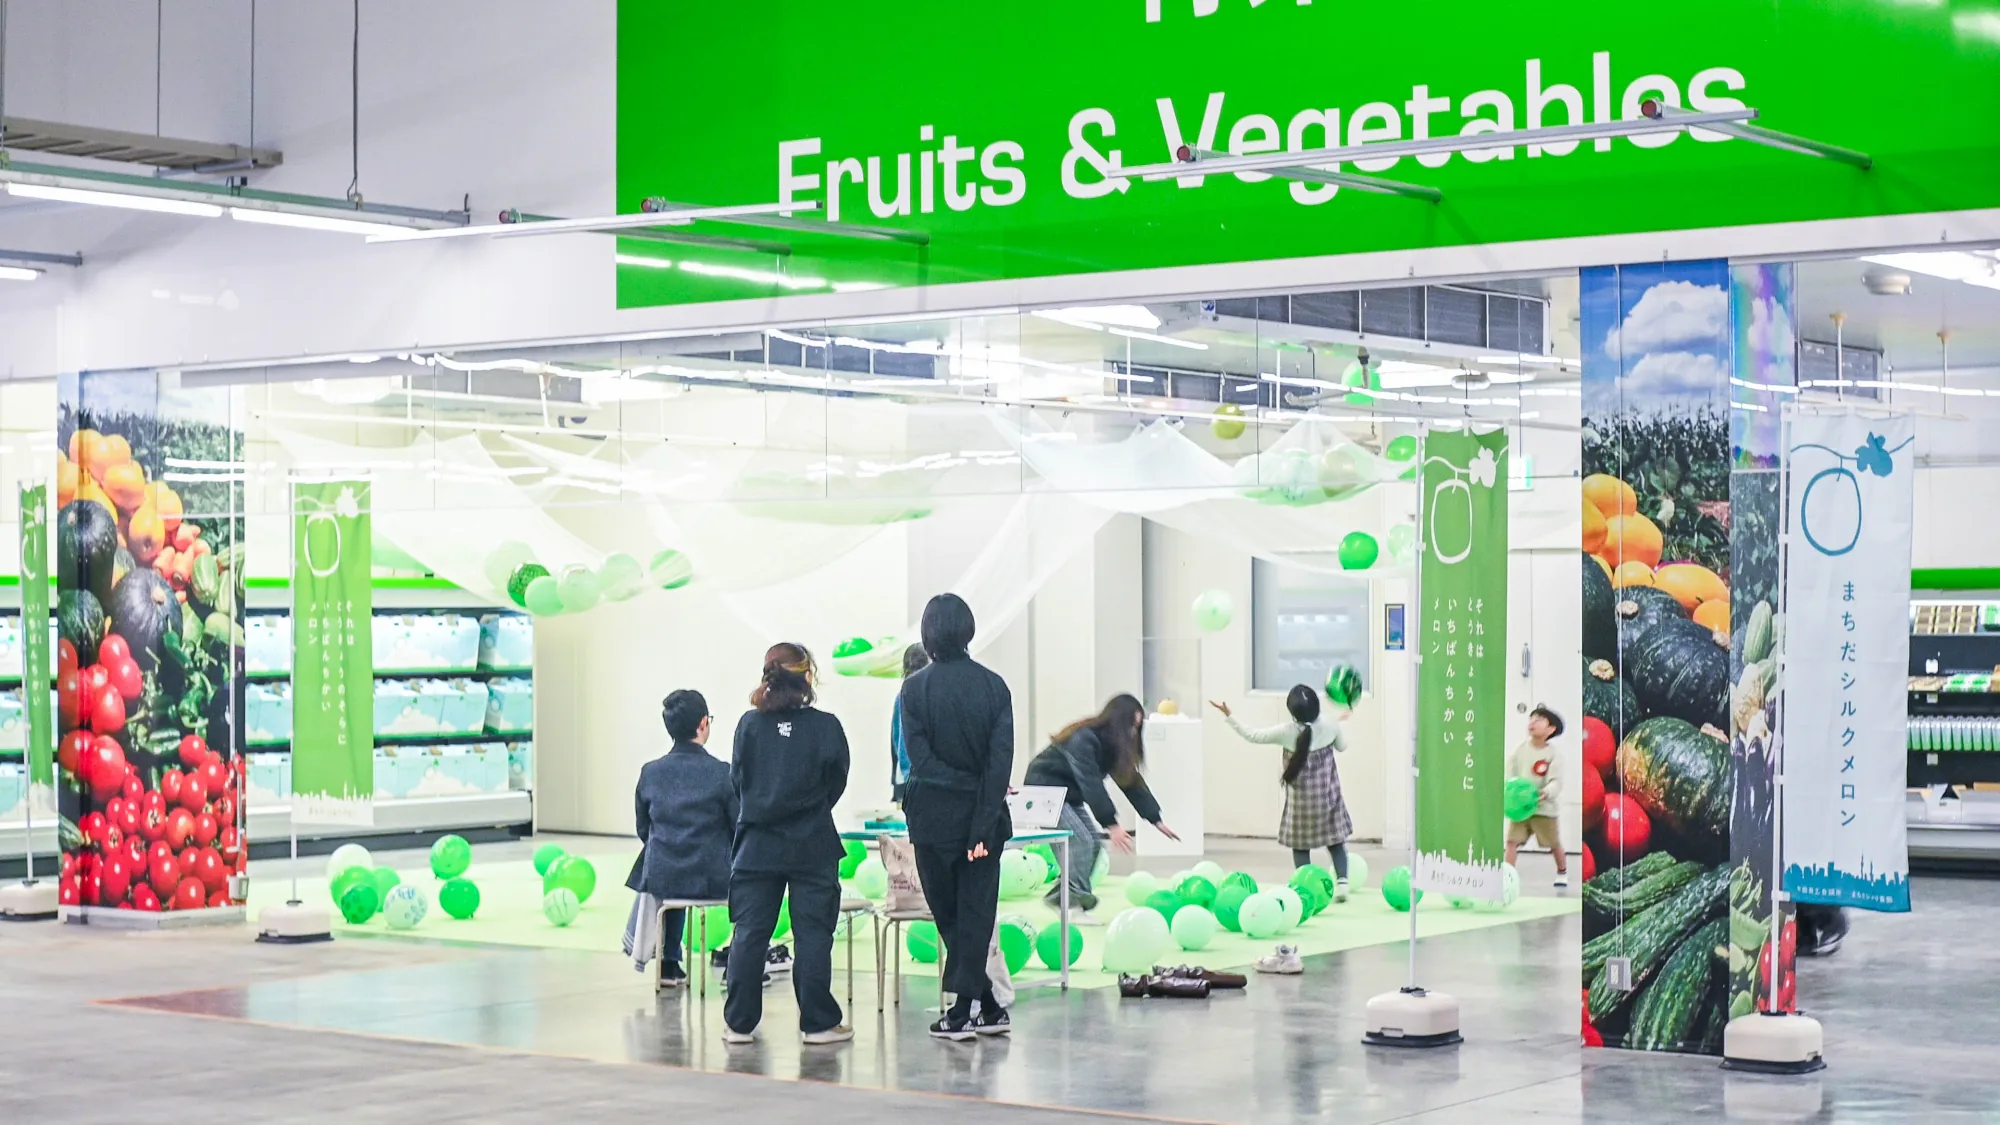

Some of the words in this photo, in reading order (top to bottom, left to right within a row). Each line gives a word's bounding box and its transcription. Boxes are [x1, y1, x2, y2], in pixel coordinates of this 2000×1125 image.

[778, 124, 1026, 222] Fruits
[1061, 106, 1131, 199] &
[1156, 50, 1748, 206] Vegetables
[1443, 597, 1458, 744] いちばんちかい
[1475, 597, 1485, 658] それは
[1839, 580, 1857, 827] まちだシルクメロン
